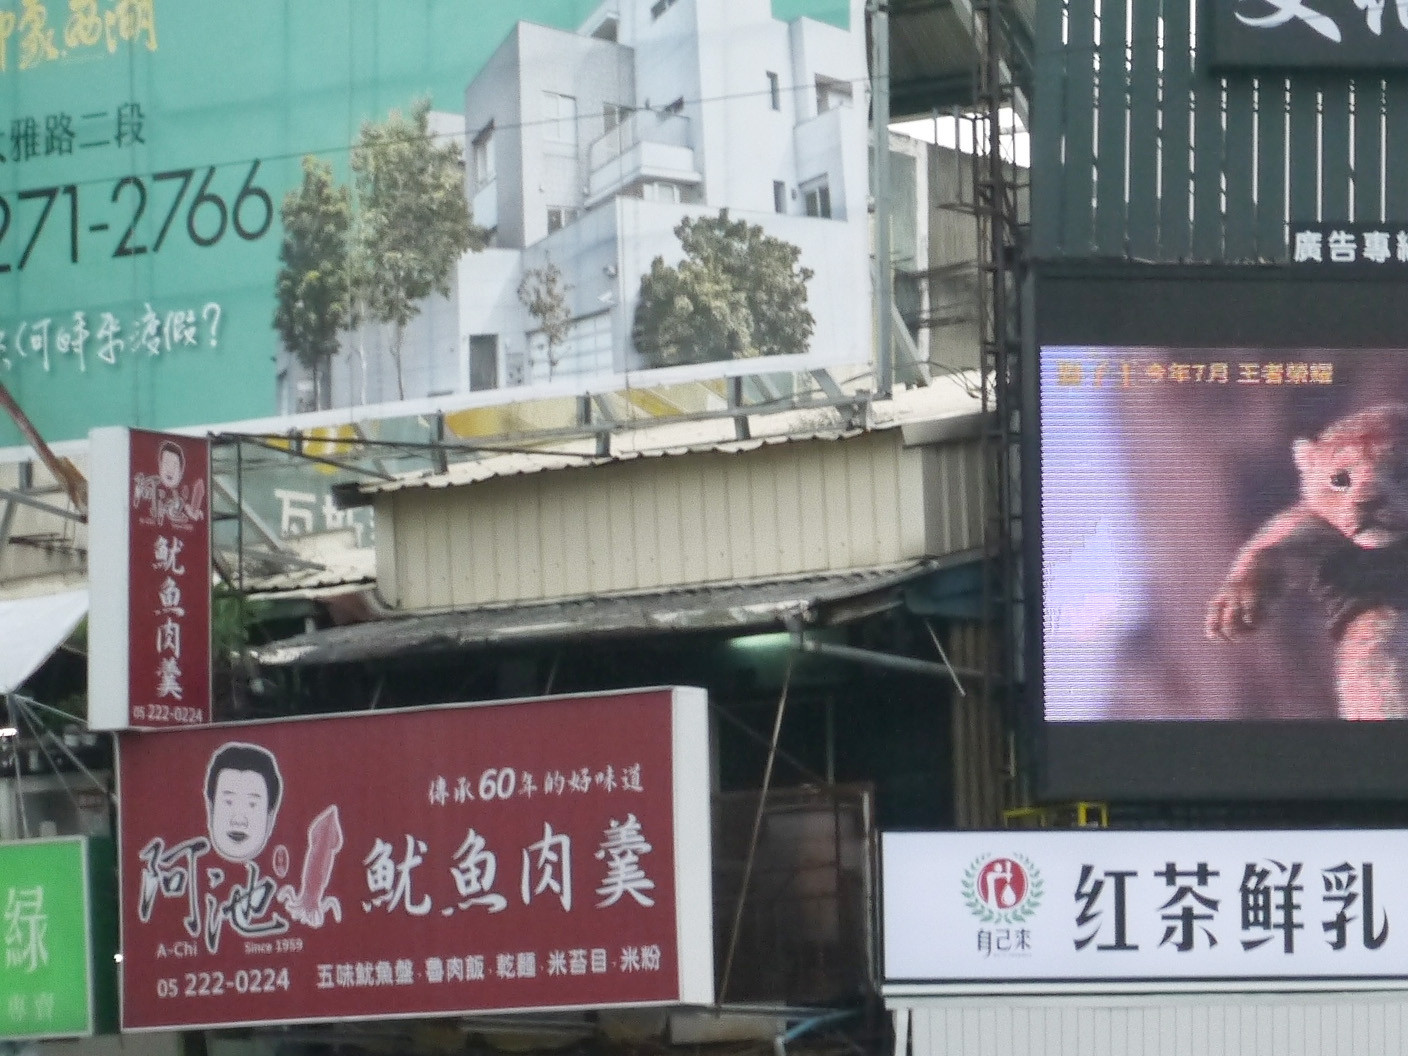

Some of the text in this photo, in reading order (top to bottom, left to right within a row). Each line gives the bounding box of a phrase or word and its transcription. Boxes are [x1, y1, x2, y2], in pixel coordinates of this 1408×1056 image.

[0, 101, 146, 163] 雅路二段
[0, 158, 274, 274] 71-2766
[152, 534, 185, 700] 魷魚肉羹
[361, 812, 657, 918] 魷魚肉羹
[156, 967, 291, 998] 05 222-0224
[157, 941, 198, 959] A-Chi
